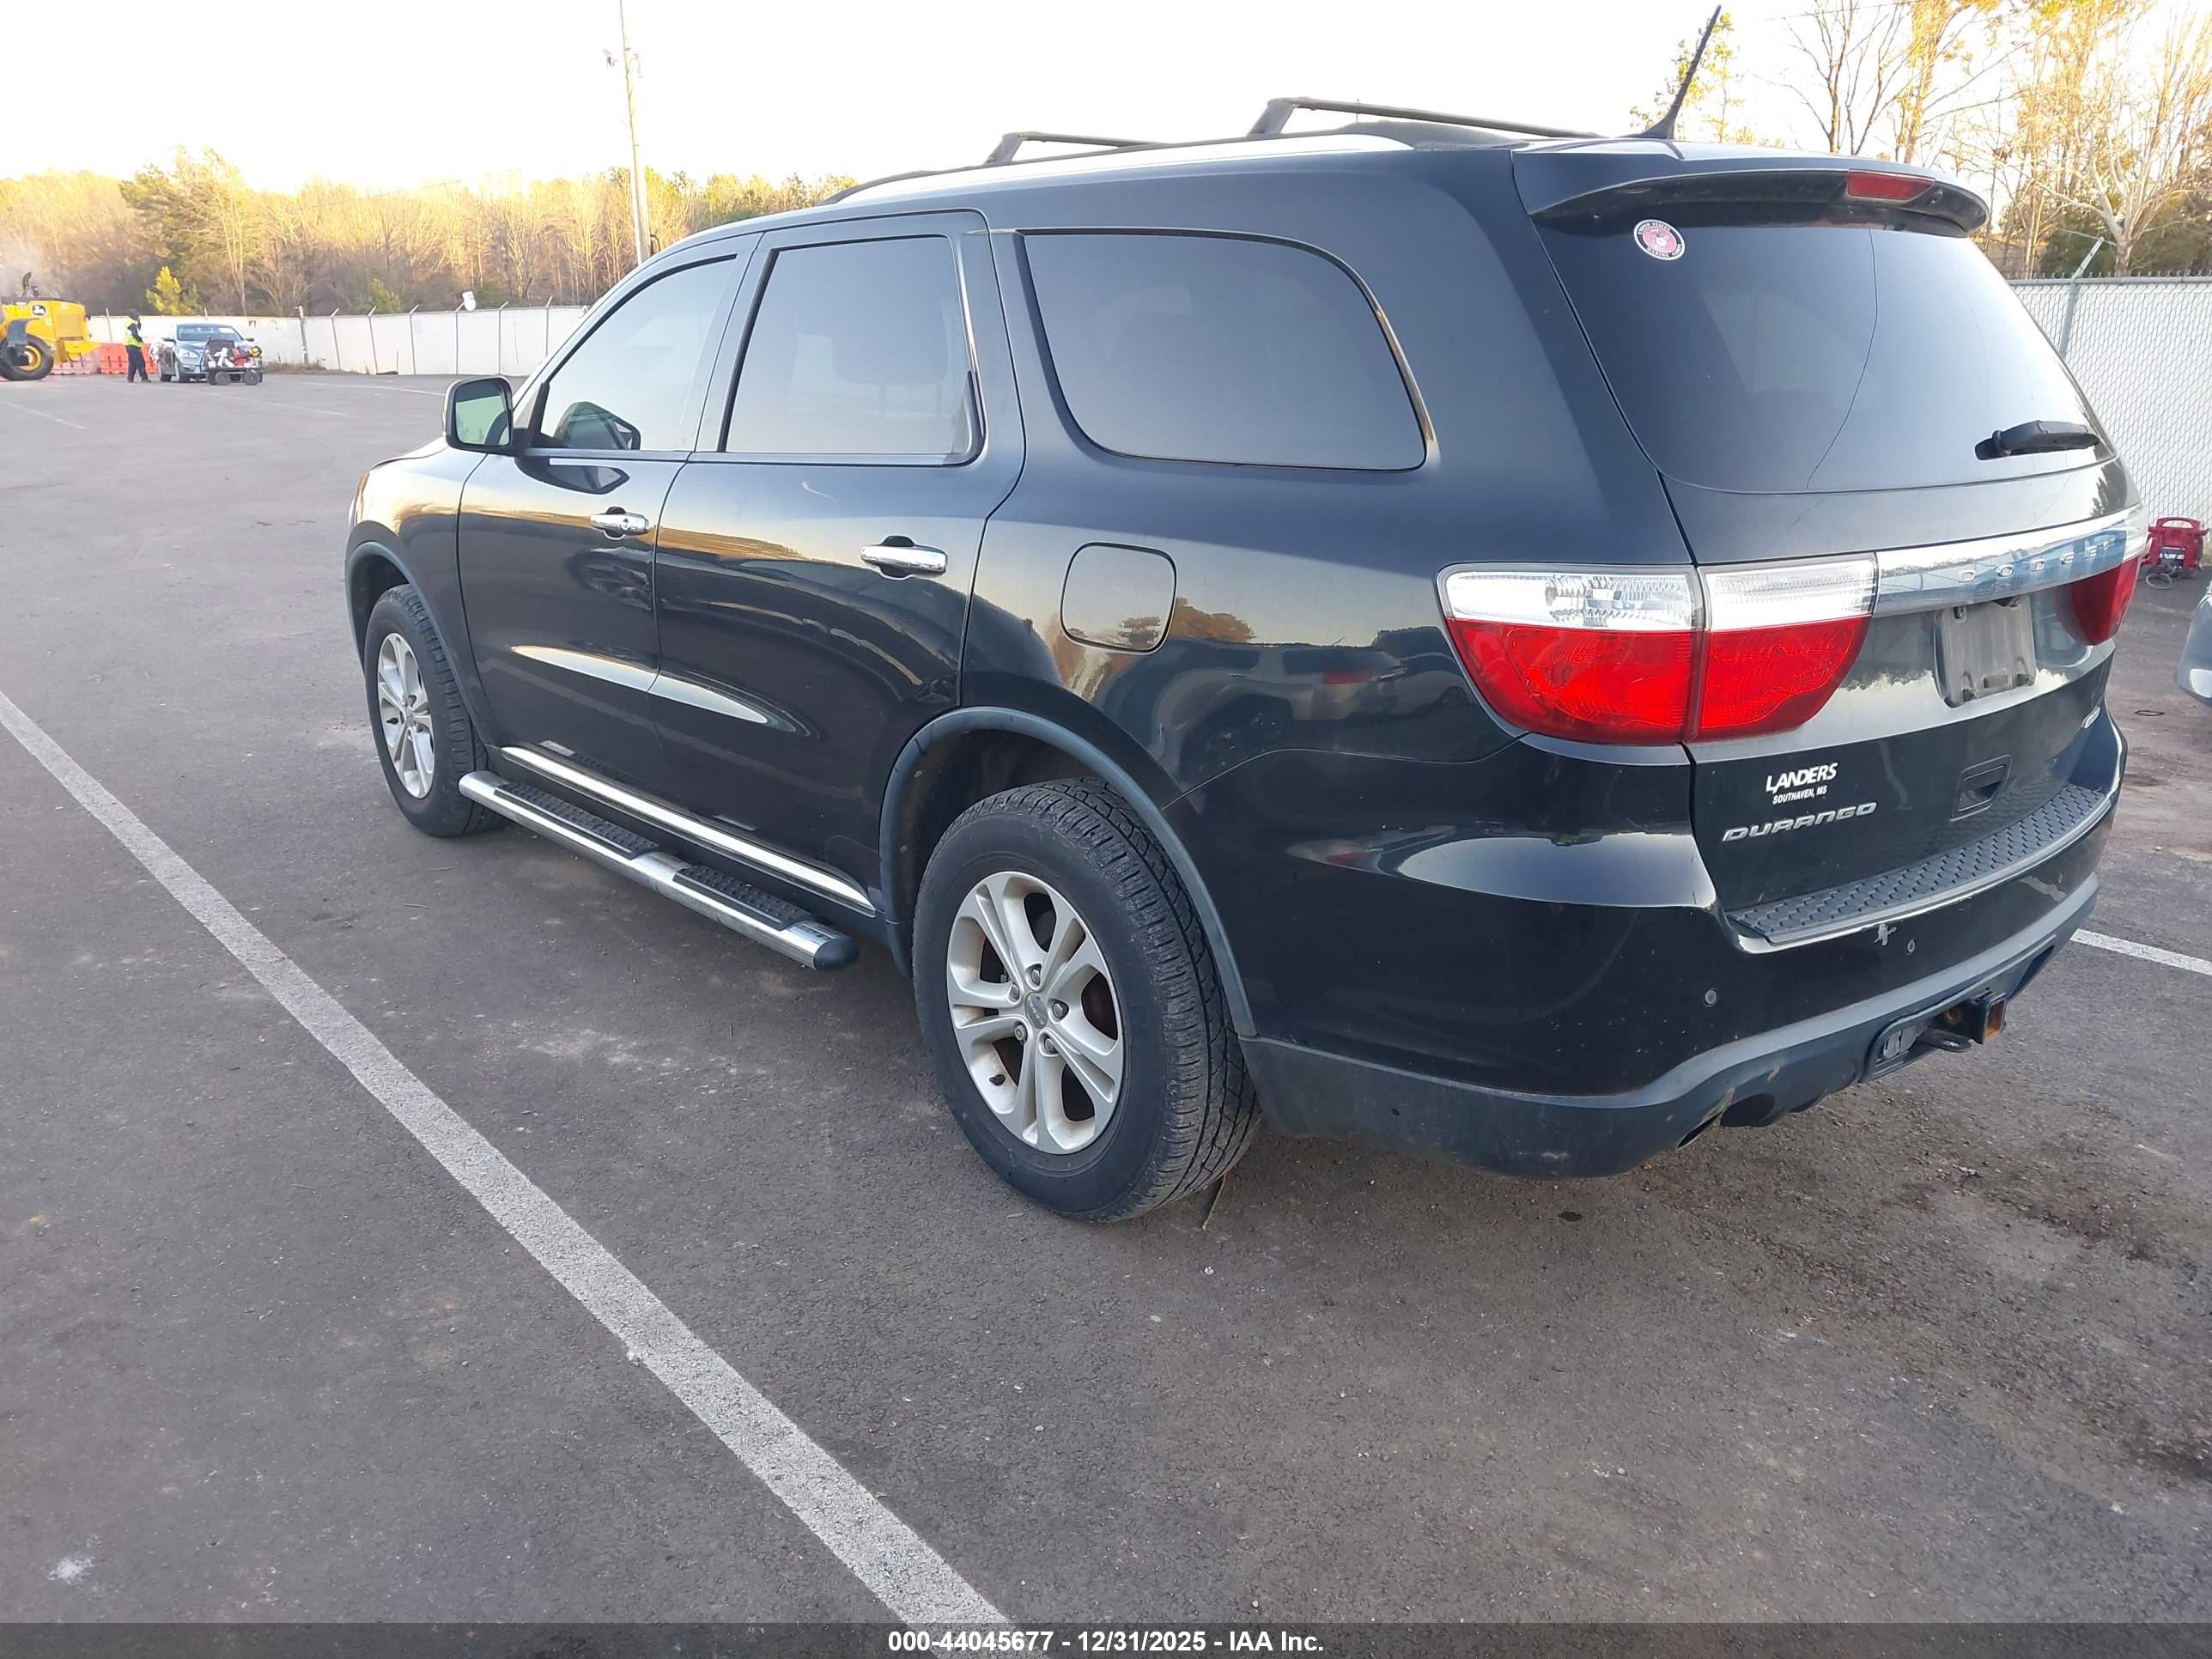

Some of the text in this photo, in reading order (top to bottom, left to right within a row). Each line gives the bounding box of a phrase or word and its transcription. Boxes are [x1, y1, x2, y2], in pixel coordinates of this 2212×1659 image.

[1958, 544, 2098, 583] DODGE
[1765, 762, 1838, 794] LANDERS
[1772, 784, 1828, 805] SOUTHAVEN, MS
[1722, 801, 1877, 842] DURANGO
